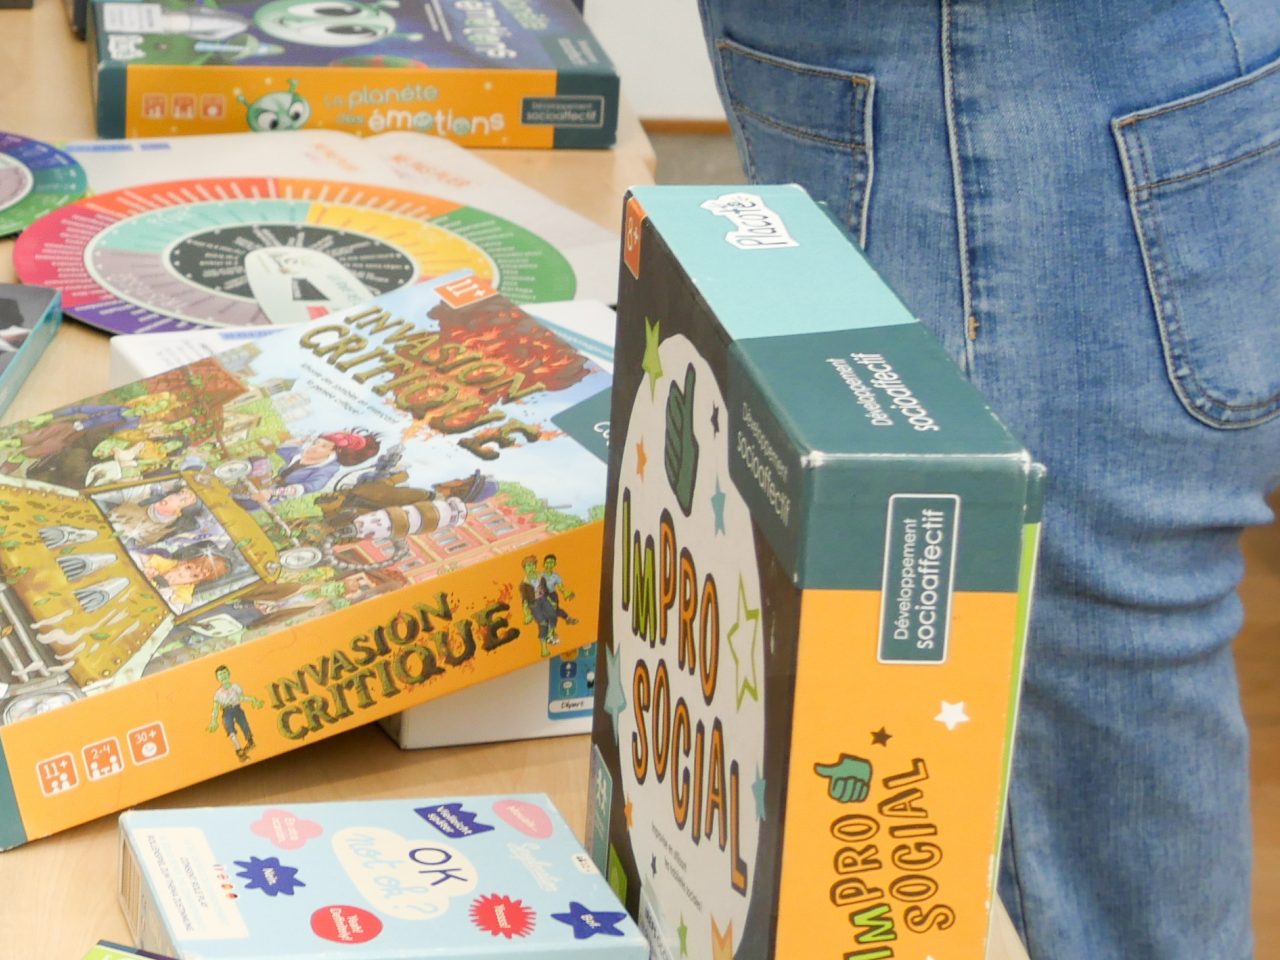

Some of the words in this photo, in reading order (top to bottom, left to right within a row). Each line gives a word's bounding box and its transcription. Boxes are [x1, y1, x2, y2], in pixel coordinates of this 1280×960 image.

[349, 84, 438, 107] planète
[369, 108, 505, 135] émotions
[526, 110, 597, 122] socioaffectif
[725, 198, 789, 246] Placote
[300, 324, 541, 460] CRITIQUE
[344, 306, 547, 404] INVASION
[826, 358, 894, 427] Développement
[850, 352, 940, 431] socioaffectif
[737, 430, 790, 527] socioaffectif
[621, 486, 719, 706] IMPRO
[894, 518, 918, 641] Développement
[917, 508, 946, 649] socioaffectif
[267, 591, 453, 710] INVASION
[277, 602, 520, 740] CRITIQUE
[44, 759, 68, 778] 11+
[91, 744, 111, 760] 2-4
[134, 729, 157, 744] 30+
[631, 658, 748, 897] SOCIAL
[408, 847, 468, 886] OK
[830, 814, 898, 960] IMPRO
[878, 758, 956, 933] SOCIAL
